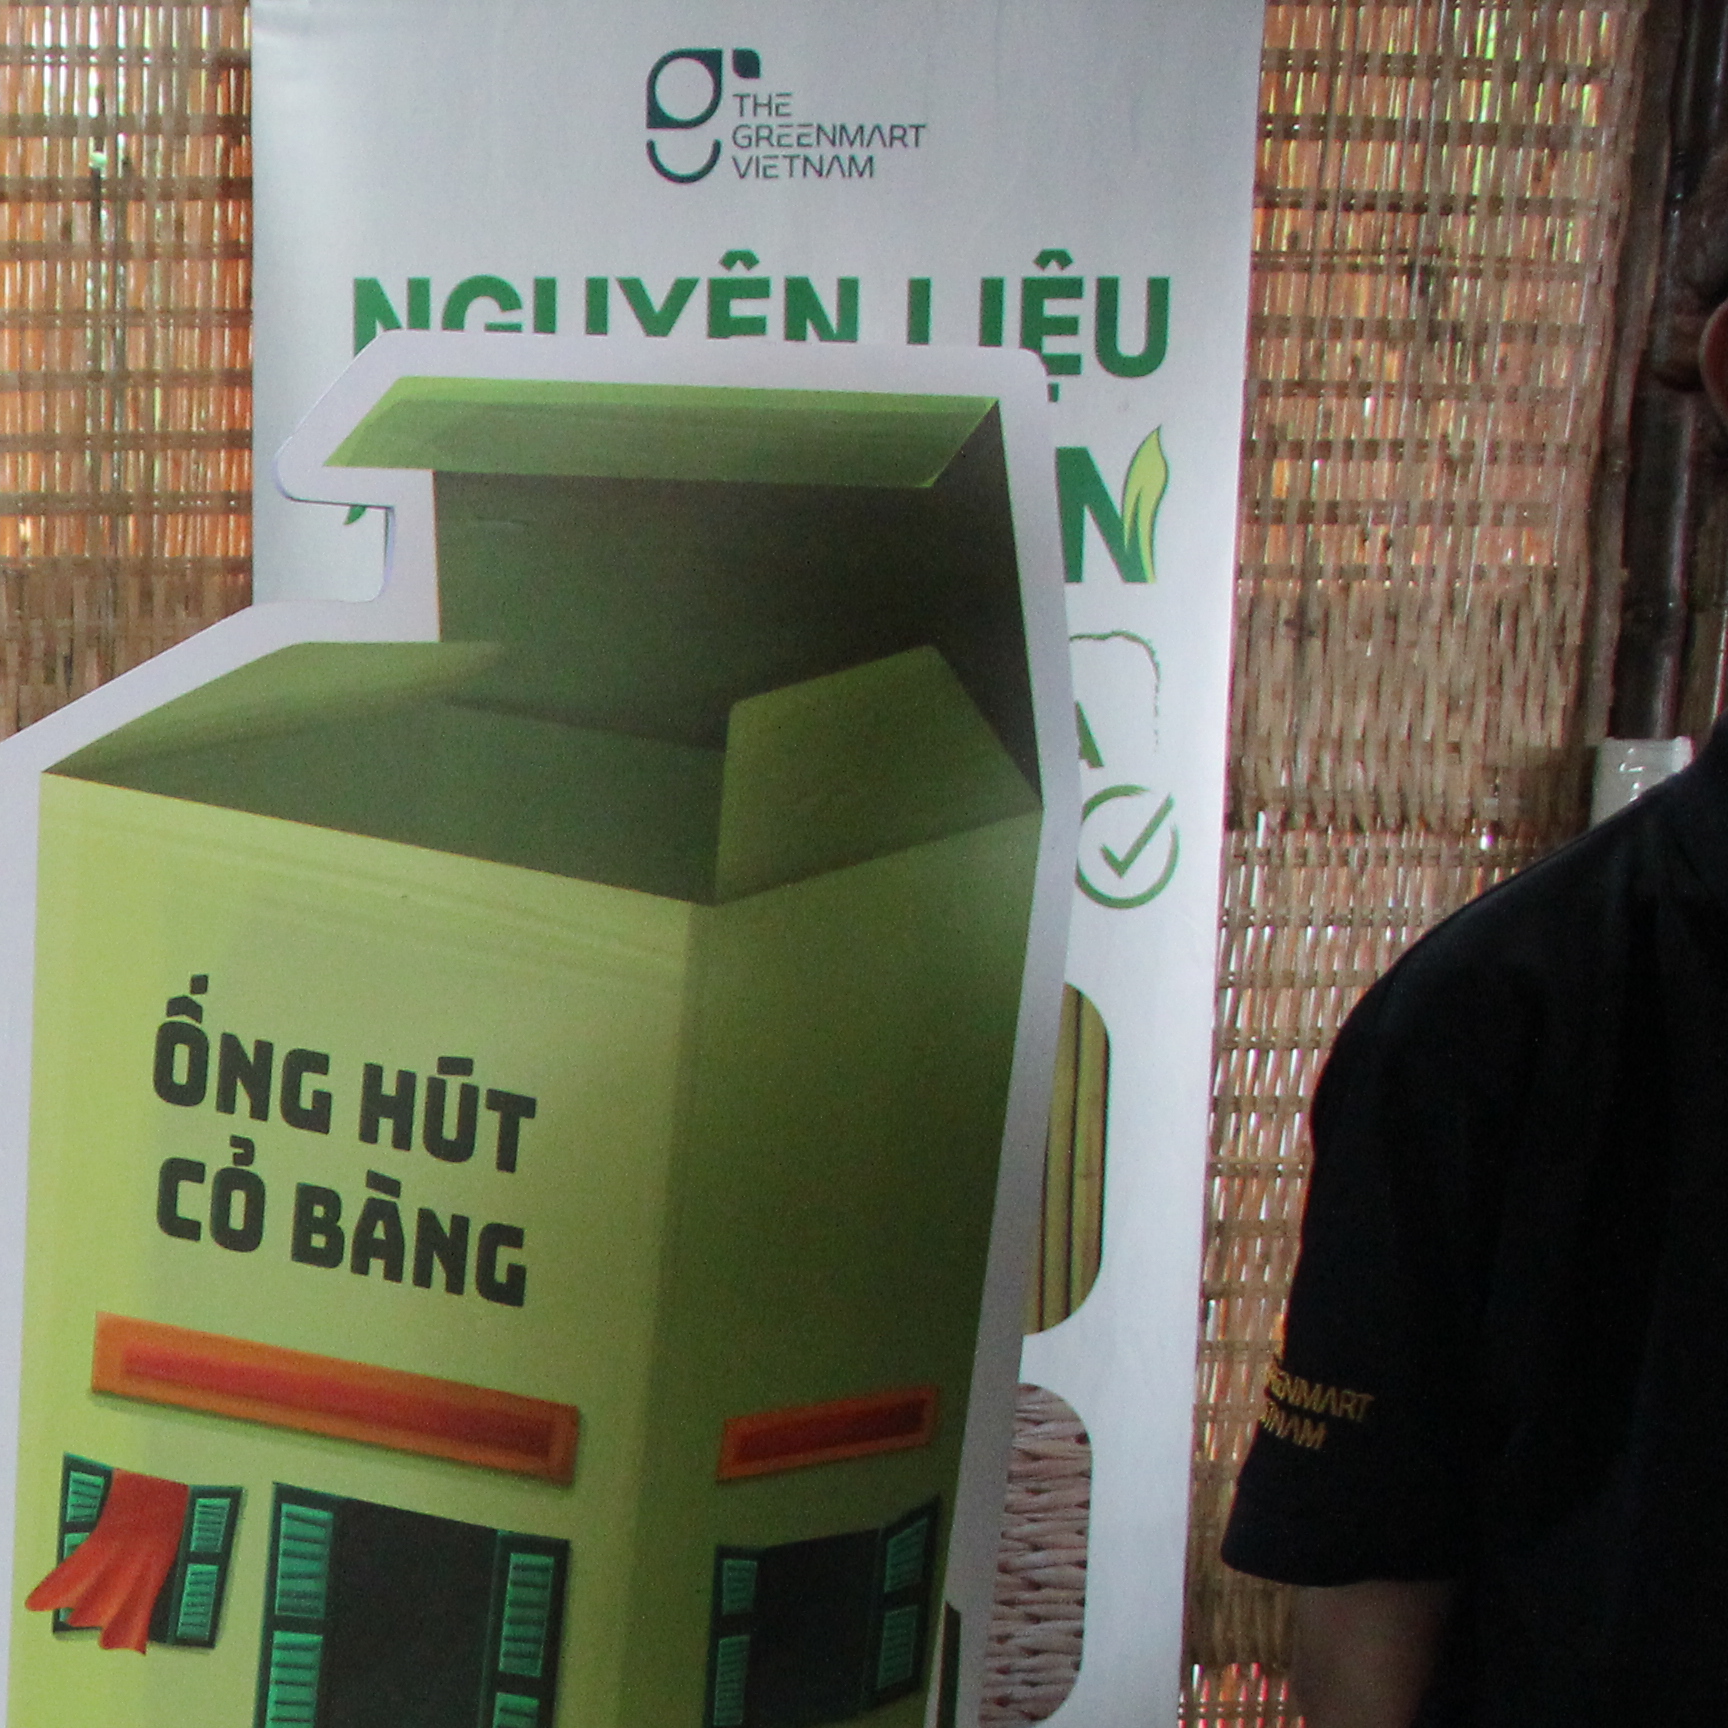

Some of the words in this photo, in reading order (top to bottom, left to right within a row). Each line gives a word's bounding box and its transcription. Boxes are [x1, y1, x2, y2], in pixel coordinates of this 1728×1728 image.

[732, 93, 792, 117] THE
[732, 123, 927, 148] GREENMART
[732, 154, 874, 179] VIETNAM
[153, 973, 333, 1135] ỐNG
[357, 1056, 537, 1174] HÚT
[156, 1134, 267, 1253] CỎ
[290, 1169, 528, 1307] BÀNG
